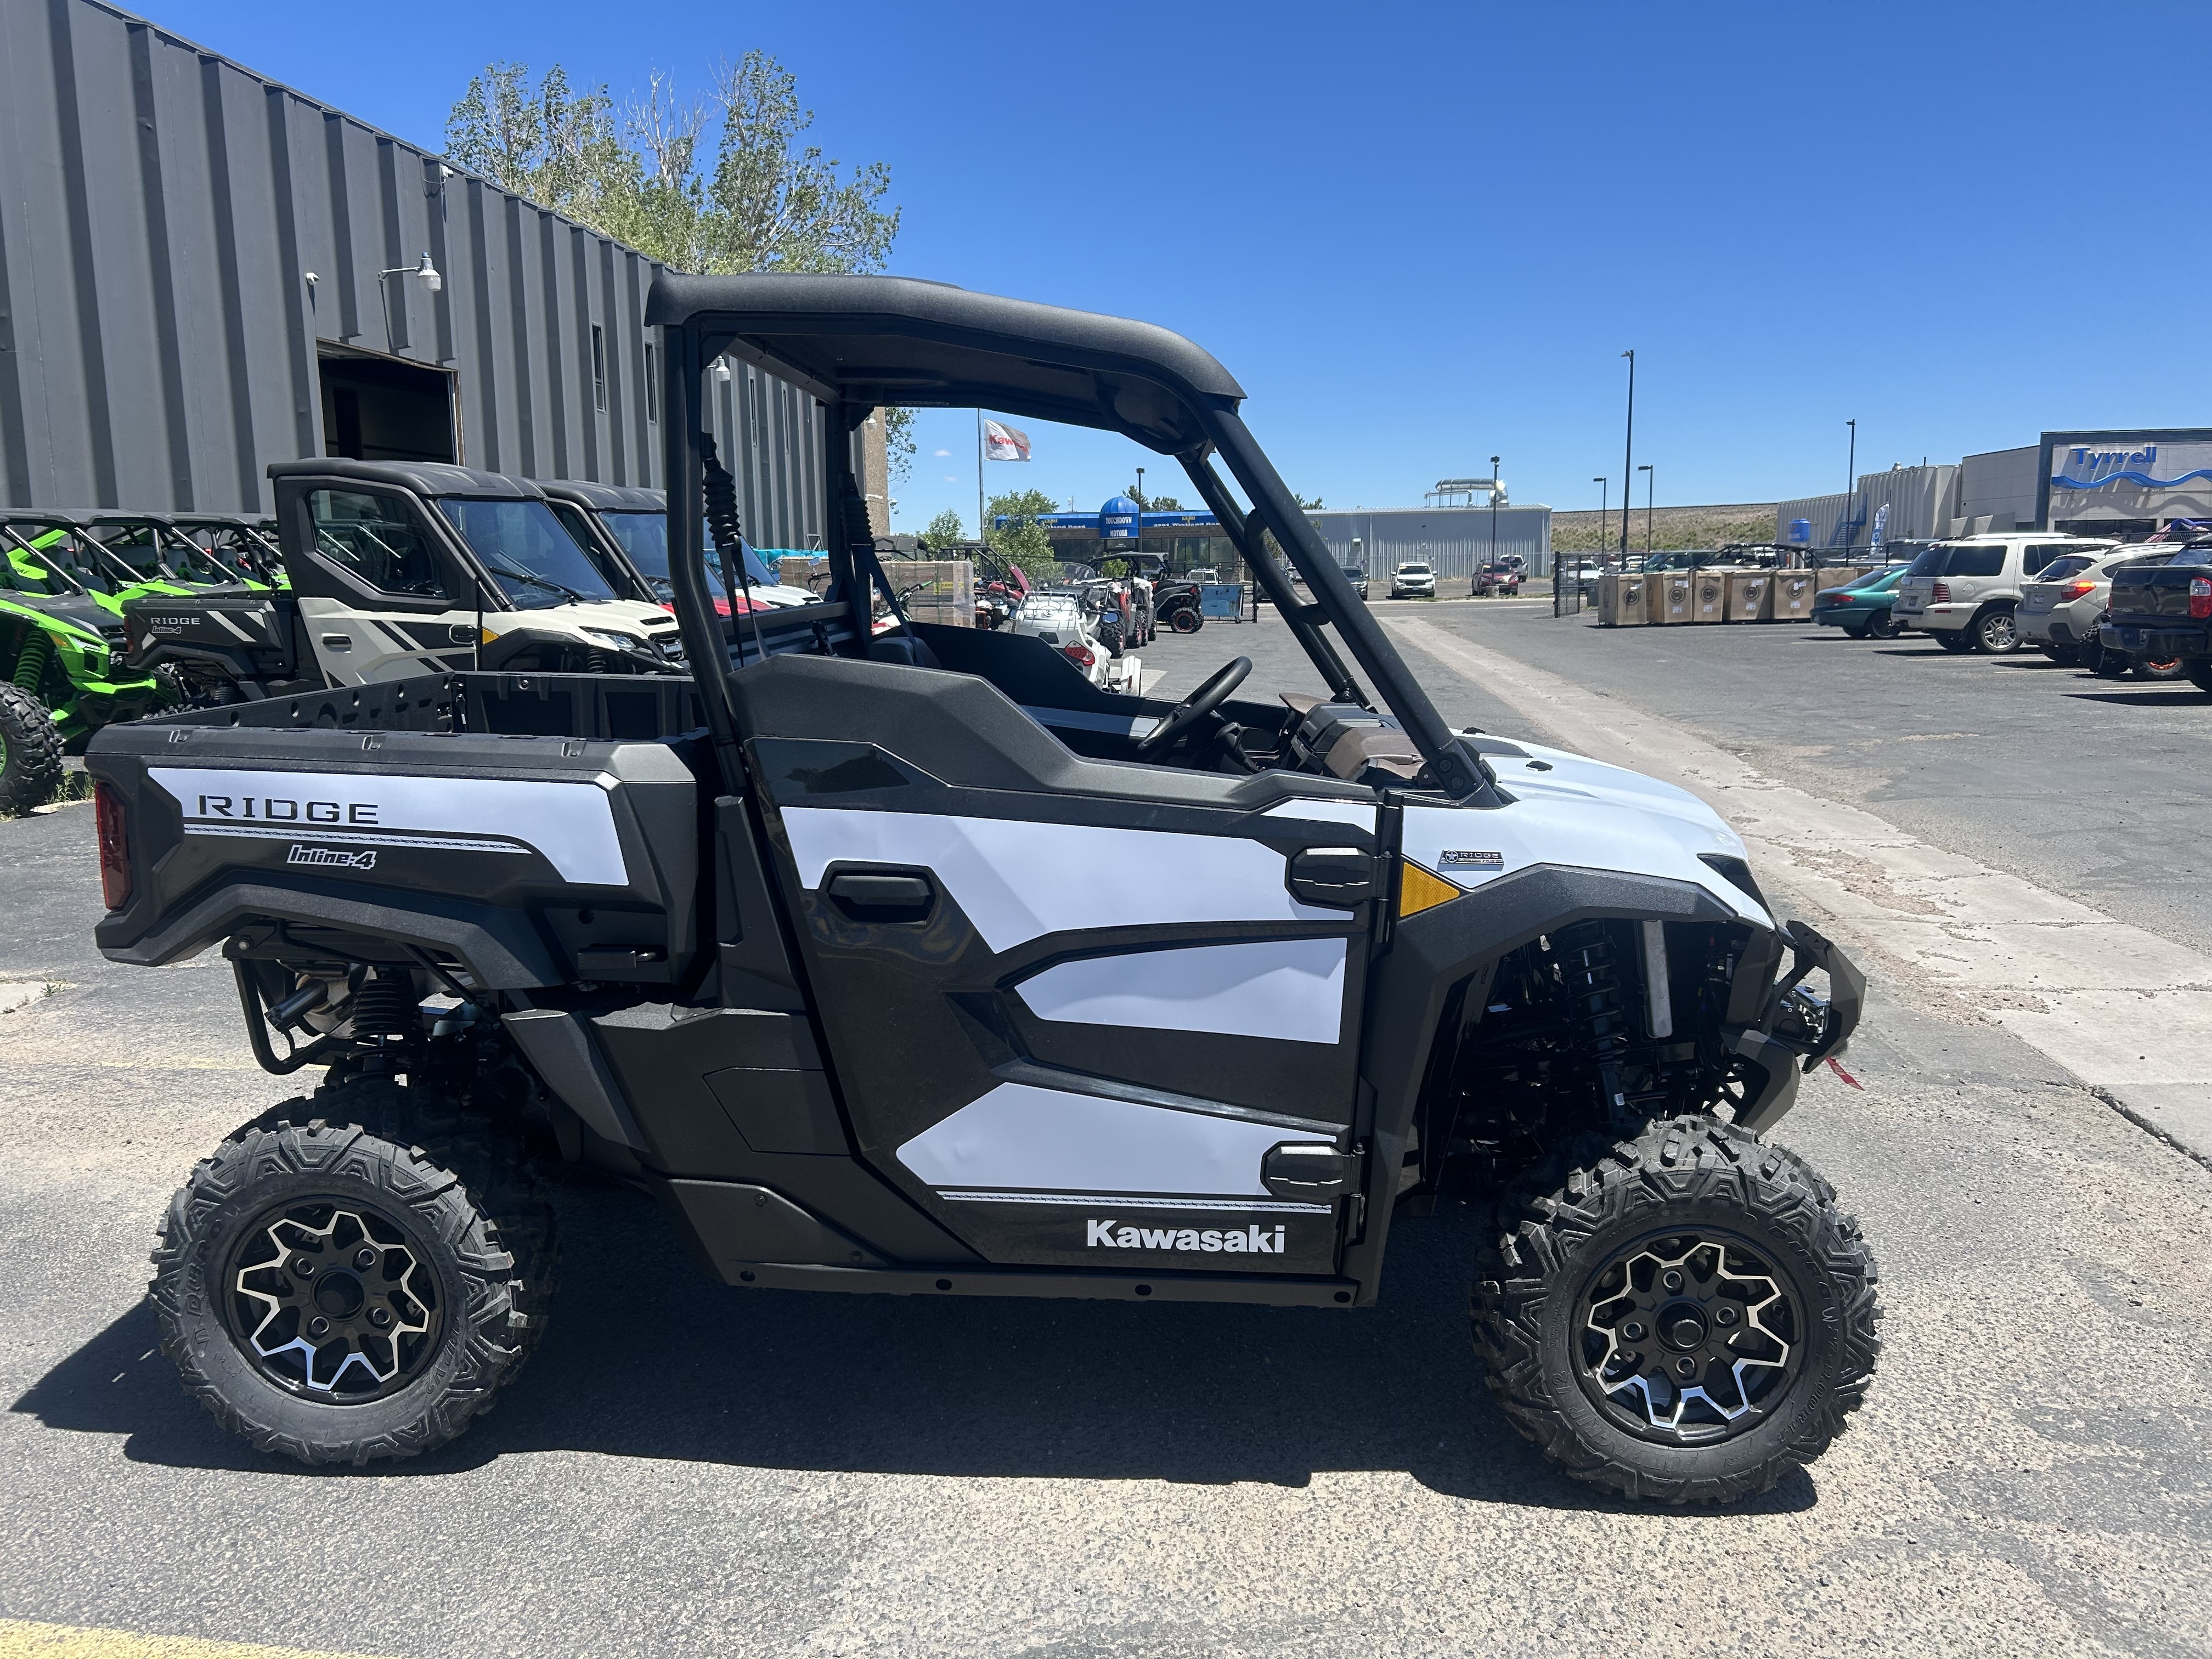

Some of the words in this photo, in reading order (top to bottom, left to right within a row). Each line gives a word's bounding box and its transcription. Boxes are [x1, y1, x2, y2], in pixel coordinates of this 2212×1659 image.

[2071, 445, 2157, 470] Tyrrell
[1105, 516, 1132, 524] TOUCHDOWN
[1110, 528, 1128, 537] MOTORS
[151, 625, 182, 634] Inline-4
[198, 794, 379, 825] RIDGE
[286, 844, 377, 870] Inline-4
[1087, 1219, 1285, 1254] Kawasaki
